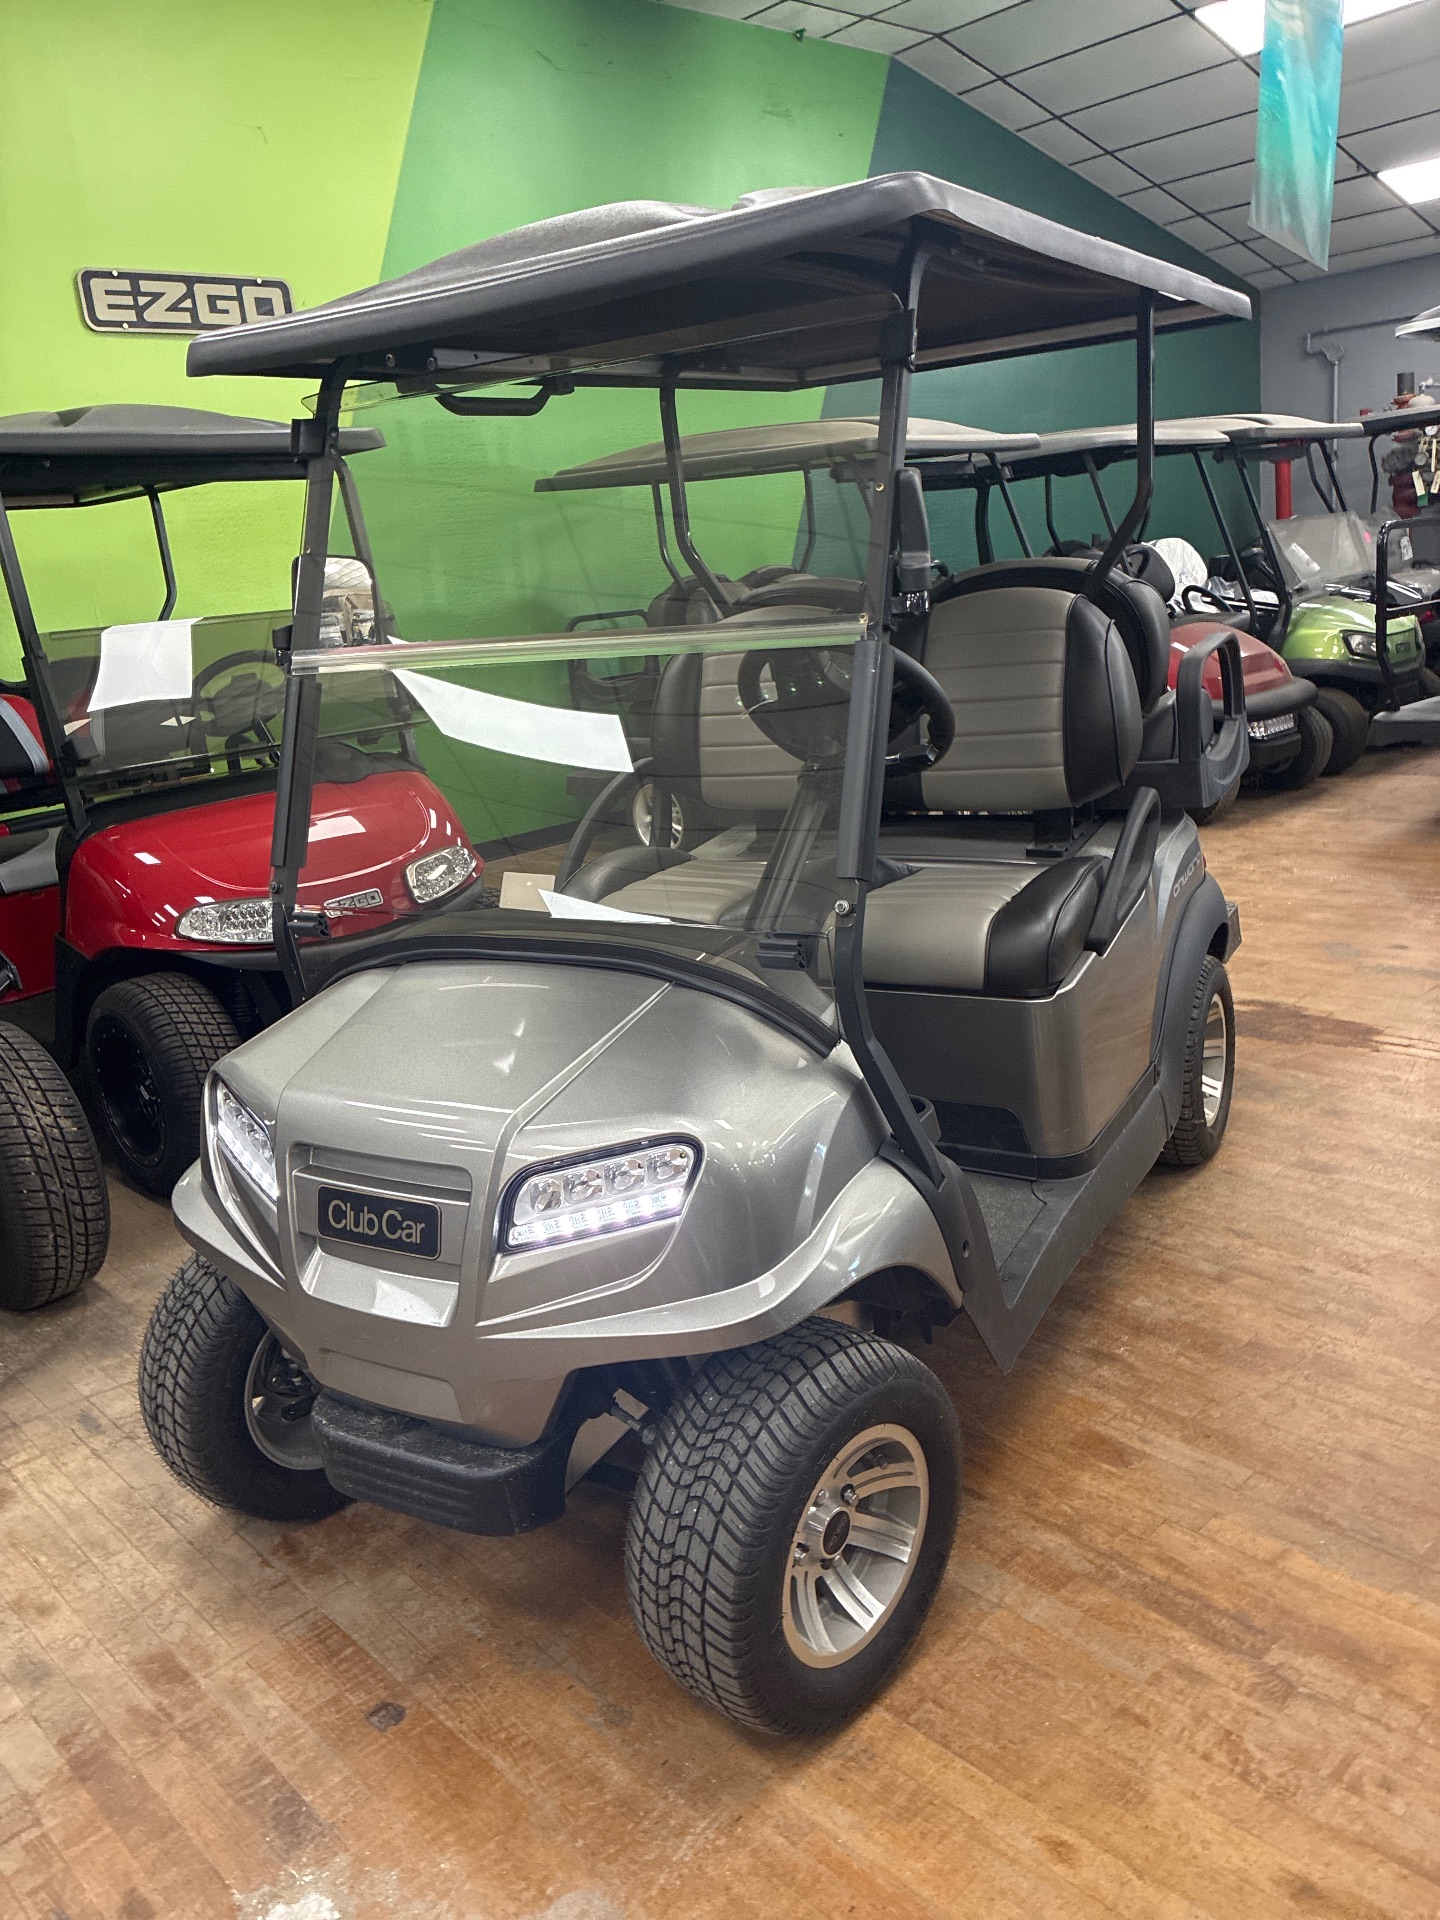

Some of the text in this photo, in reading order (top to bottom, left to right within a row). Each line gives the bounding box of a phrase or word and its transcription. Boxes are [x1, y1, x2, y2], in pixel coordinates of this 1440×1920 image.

[89, 277, 286, 326] EZGO
[328, 1199, 426, 1244] Club Car
